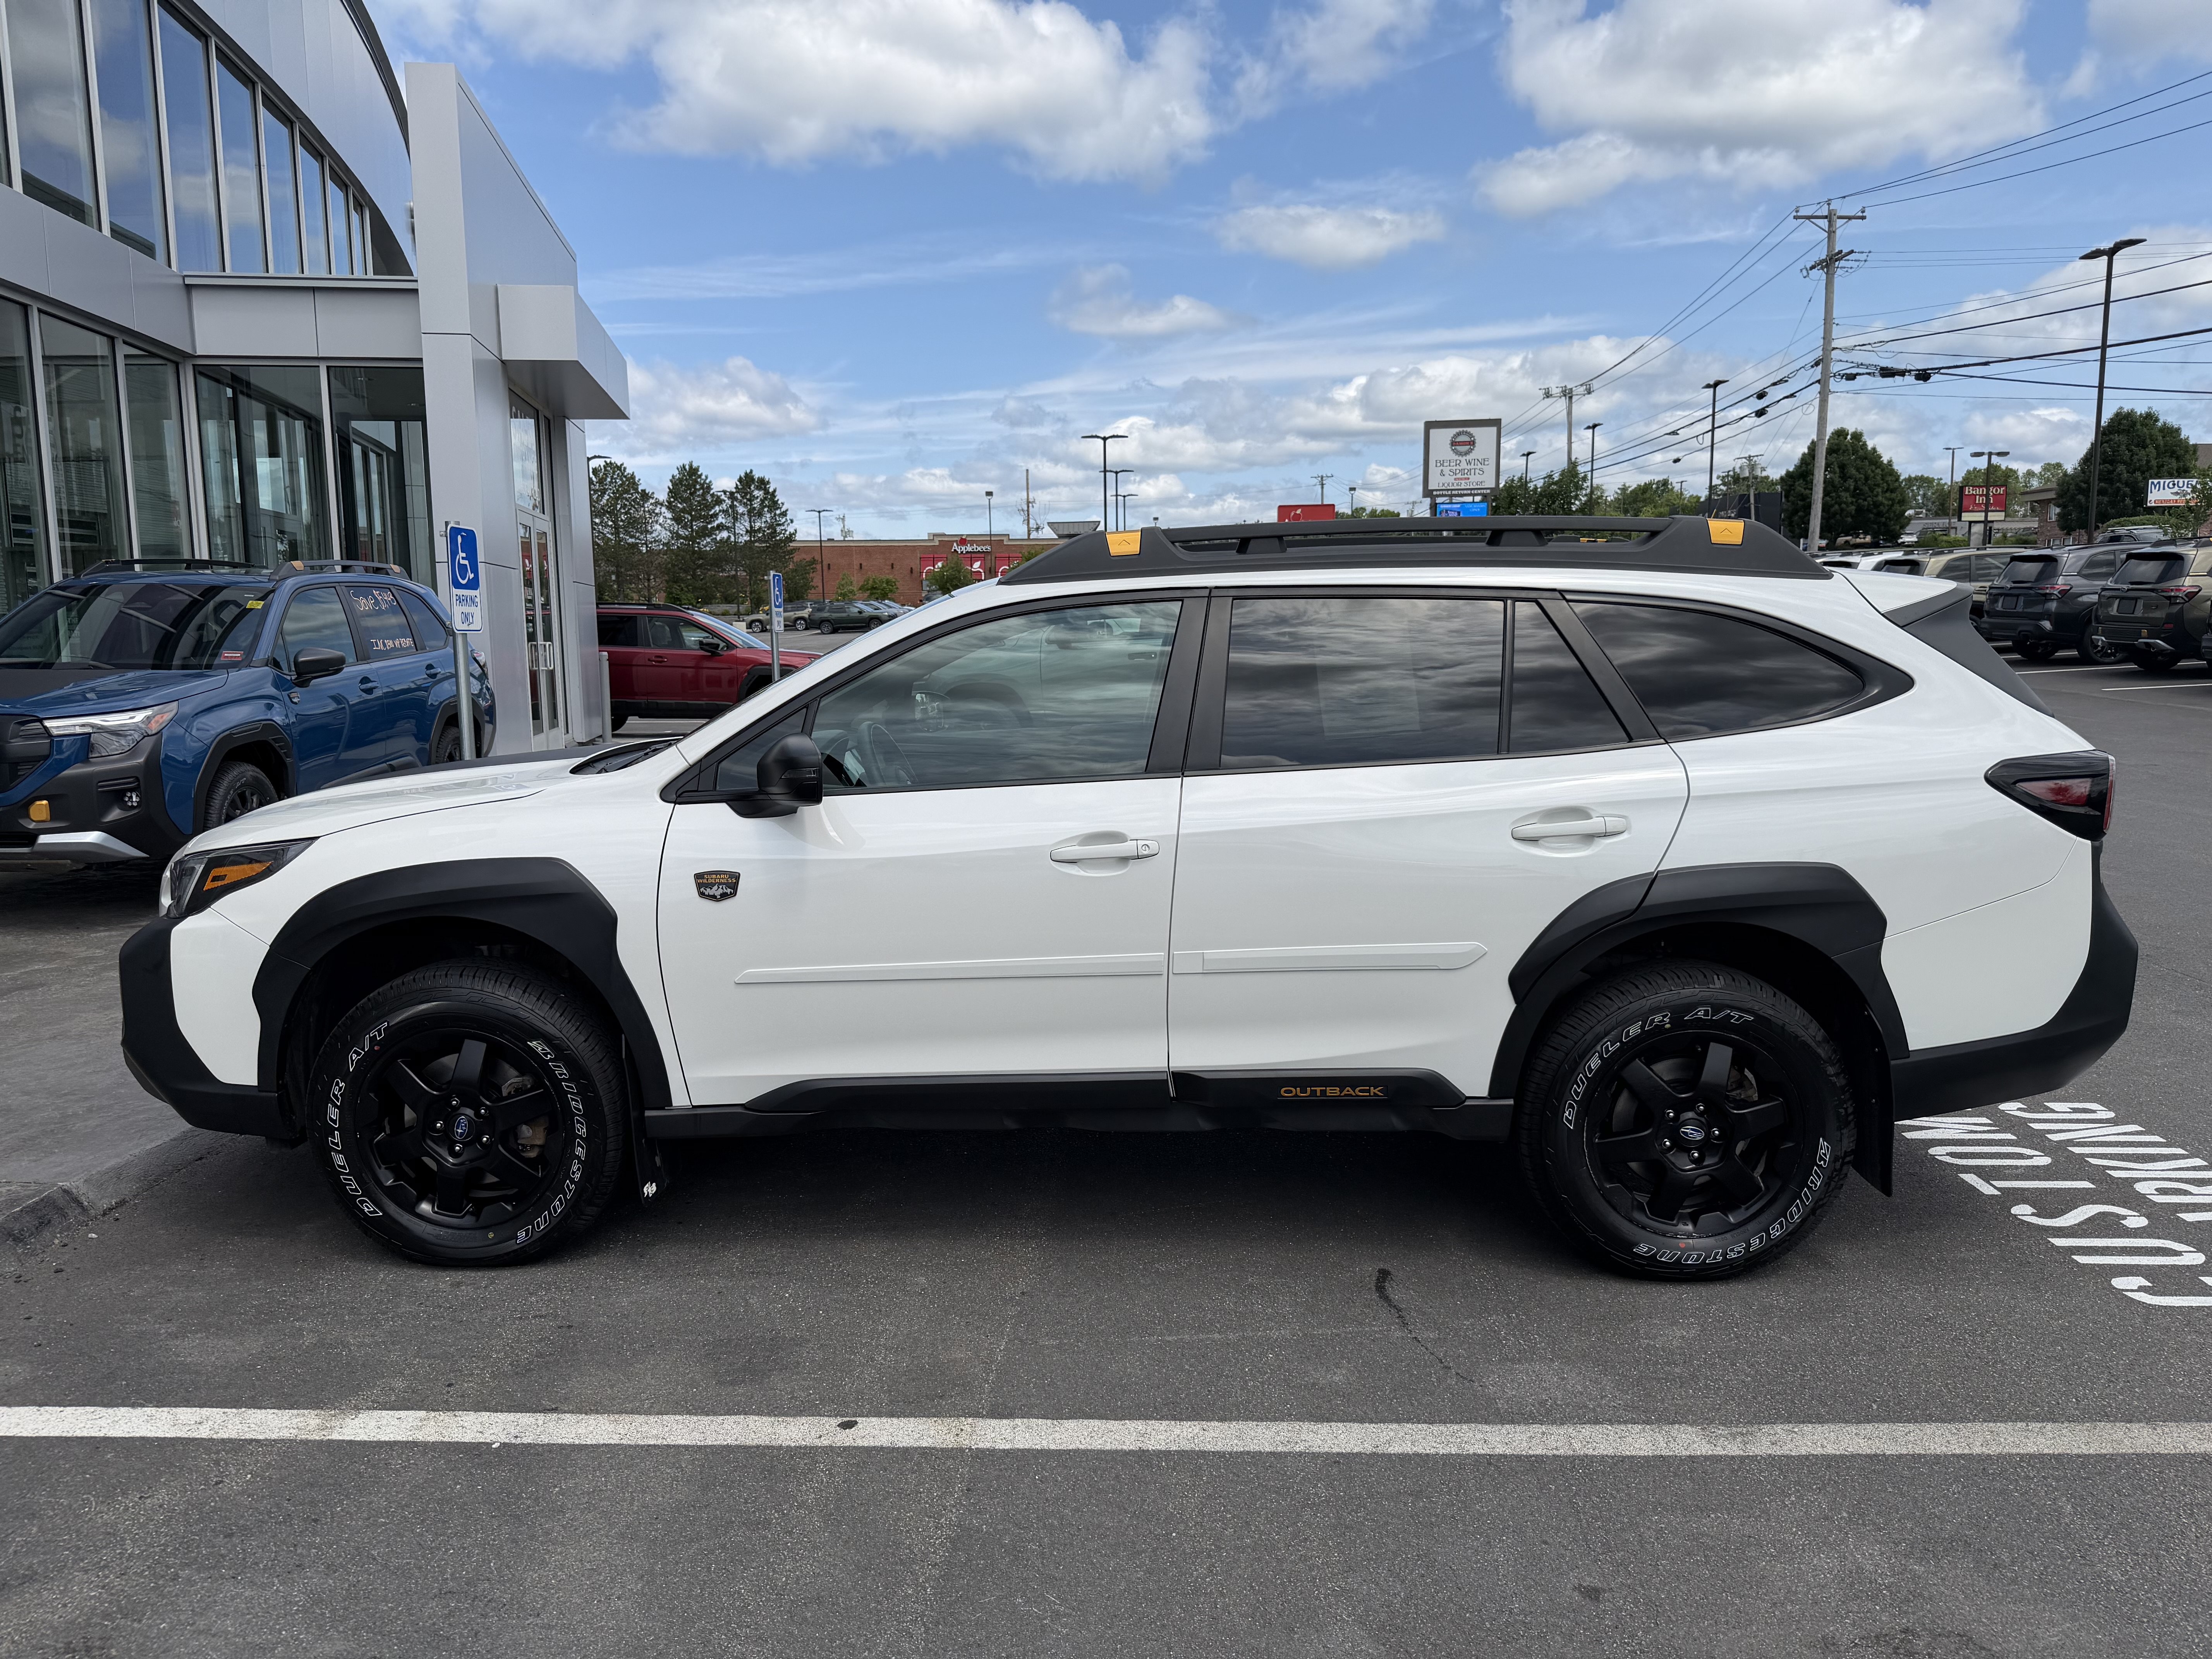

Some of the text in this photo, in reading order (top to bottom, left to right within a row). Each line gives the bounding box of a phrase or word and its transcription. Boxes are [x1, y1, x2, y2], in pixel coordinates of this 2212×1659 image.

[1435, 458, 1489, 467] BEER WINE
[1449, 468, 1484, 476] SPIRITS
[951, 542, 991, 554] Applebee's
[455, 594, 478, 608] PARKING
[461, 611, 474, 624] ONLY
[1563, 1007, 1755, 1129] DUELER A/T
[1280, 1087, 1384, 1097] OUTBACK
[327, 1021, 388, 1218] DUELER A/T
[516, 1038, 587, 1244] BRIDGESTONE
[1633, 1138, 1831, 1265] BRIDGESTONE
